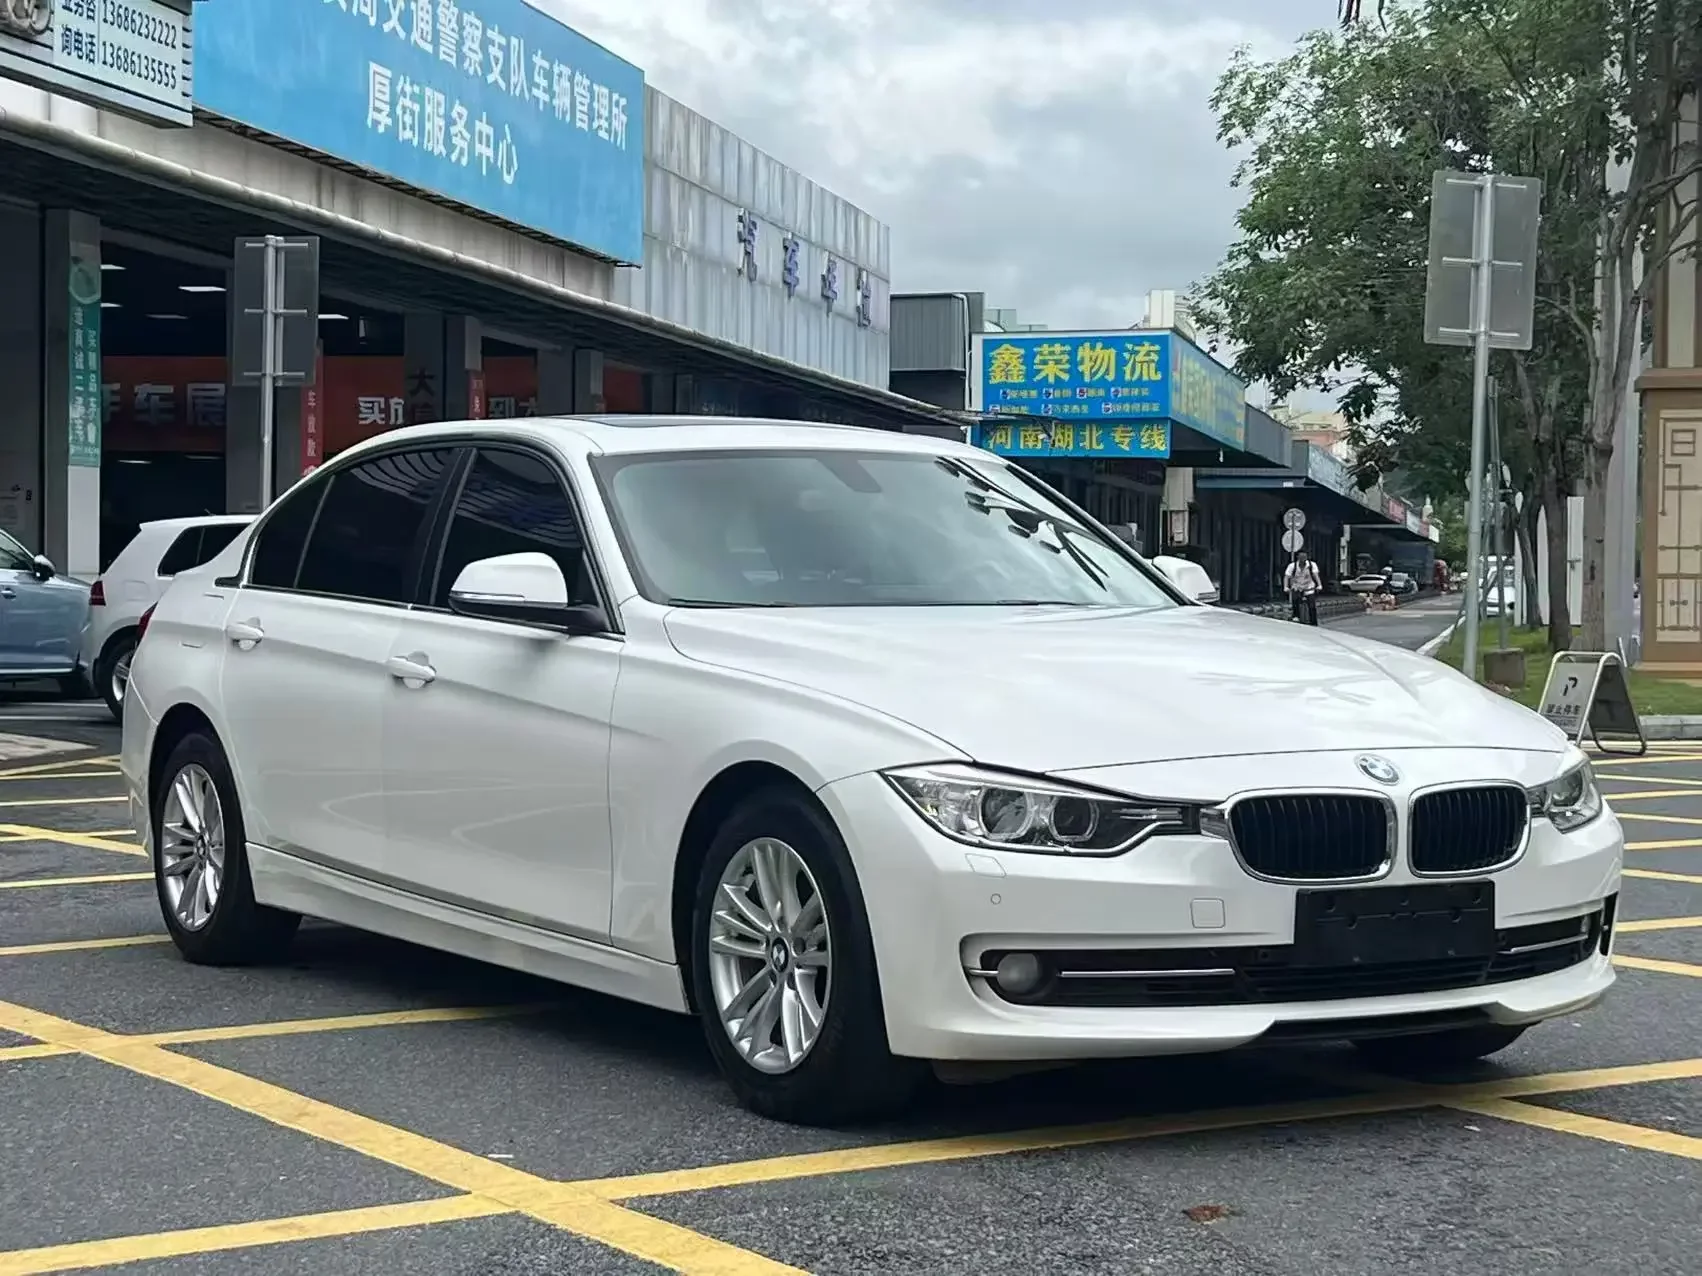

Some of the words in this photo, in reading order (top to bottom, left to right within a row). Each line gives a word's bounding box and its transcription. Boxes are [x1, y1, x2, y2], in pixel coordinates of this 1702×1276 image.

[102, 0, 177, 50] 13686232222
[61, 24, 97, 64] 询电话
[101, 41, 177, 90] 13686135555
[323, 0, 628, 151] 交通警察支队车辆管理所
[367, 61, 519, 185] 厚街服务中心
[988, 342, 1162, 384] 鑫荣物流
[988, 422, 1168, 452] 河南湖北专线
